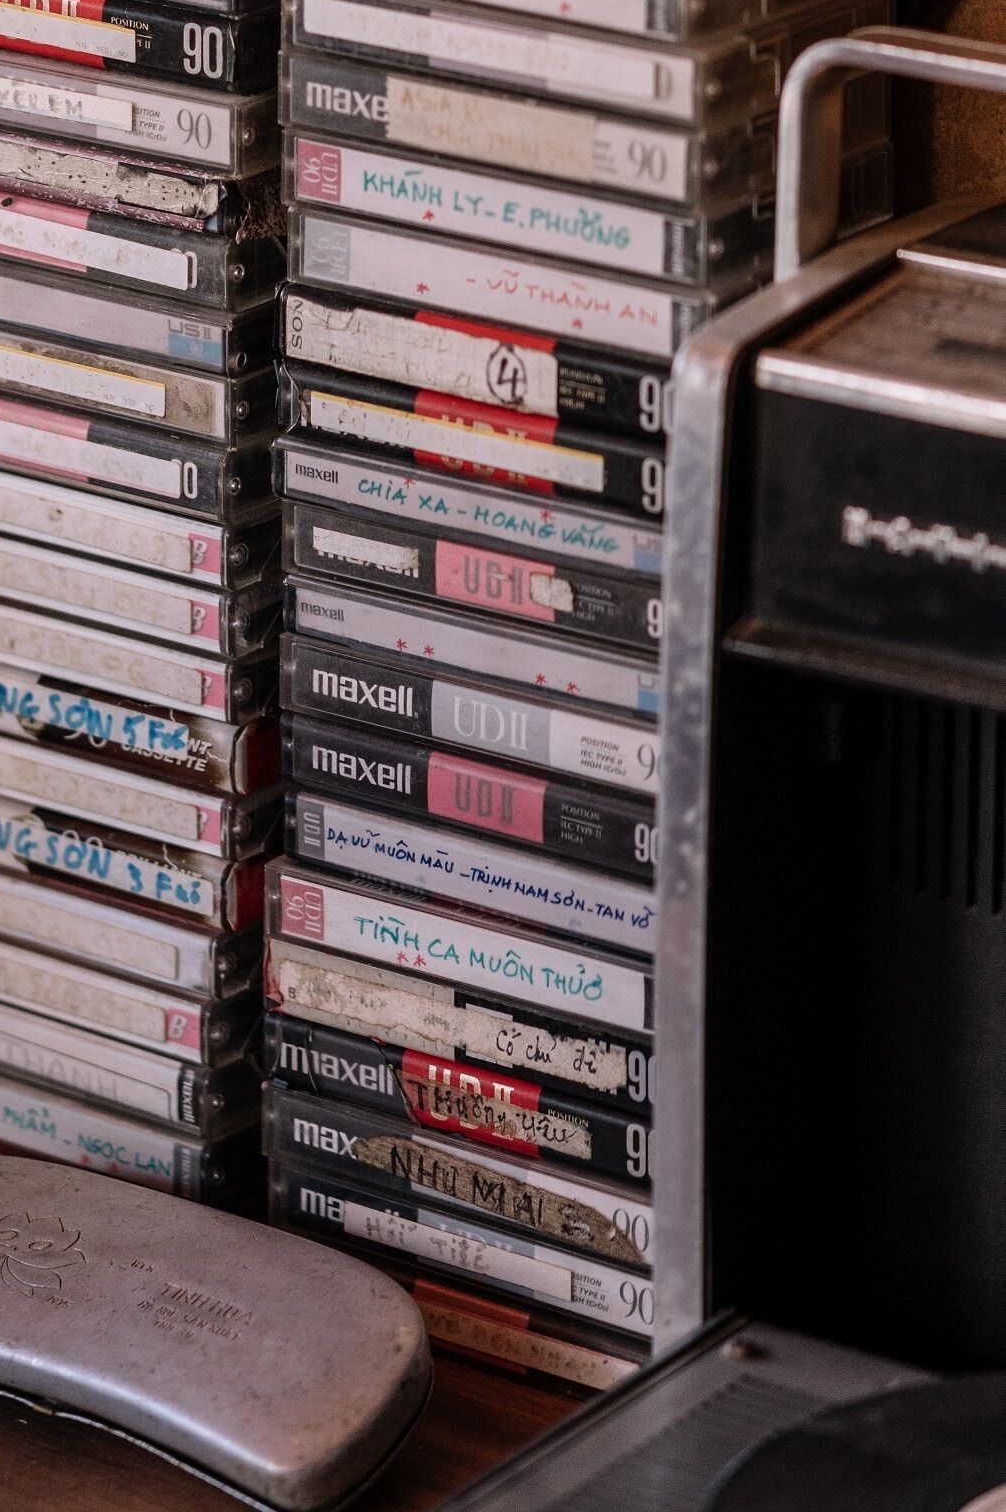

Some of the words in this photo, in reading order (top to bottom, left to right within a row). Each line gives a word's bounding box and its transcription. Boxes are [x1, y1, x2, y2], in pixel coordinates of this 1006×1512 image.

[110, 16, 150, 32] POSITION
[182, 22, 224, 80] 90
[138, 120, 161, 131] TYPE
[176, 108, 212, 150] 90
[305, 80, 389, 136] maxe
[627, 141, 667, 185] 90
[497, 357, 520, 397] 4
[294, 462, 339, 485] maxell
[418, 494, 449, 515] XA
[300, 600, 344, 623] maxell
[312, 667, 414, 717] maxell
[580, 735, 620, 752] POSITION
[311, 744, 412, 795] maxell
[375, 839, 417, 865] MUÔN
[513, 882, 550, 903] NAM
[284, 894, 305, 922] 90
[428, 937, 460, 965] CA
[468, 948, 534, 986] MUÔN
[169, 1015, 187, 1039] B
[280, 1041, 394, 1096] maxell
[293, 1117, 358, 1159] max
[547, 1108, 590, 1128] POSITION
[619, 1280, 655, 1326] 90
